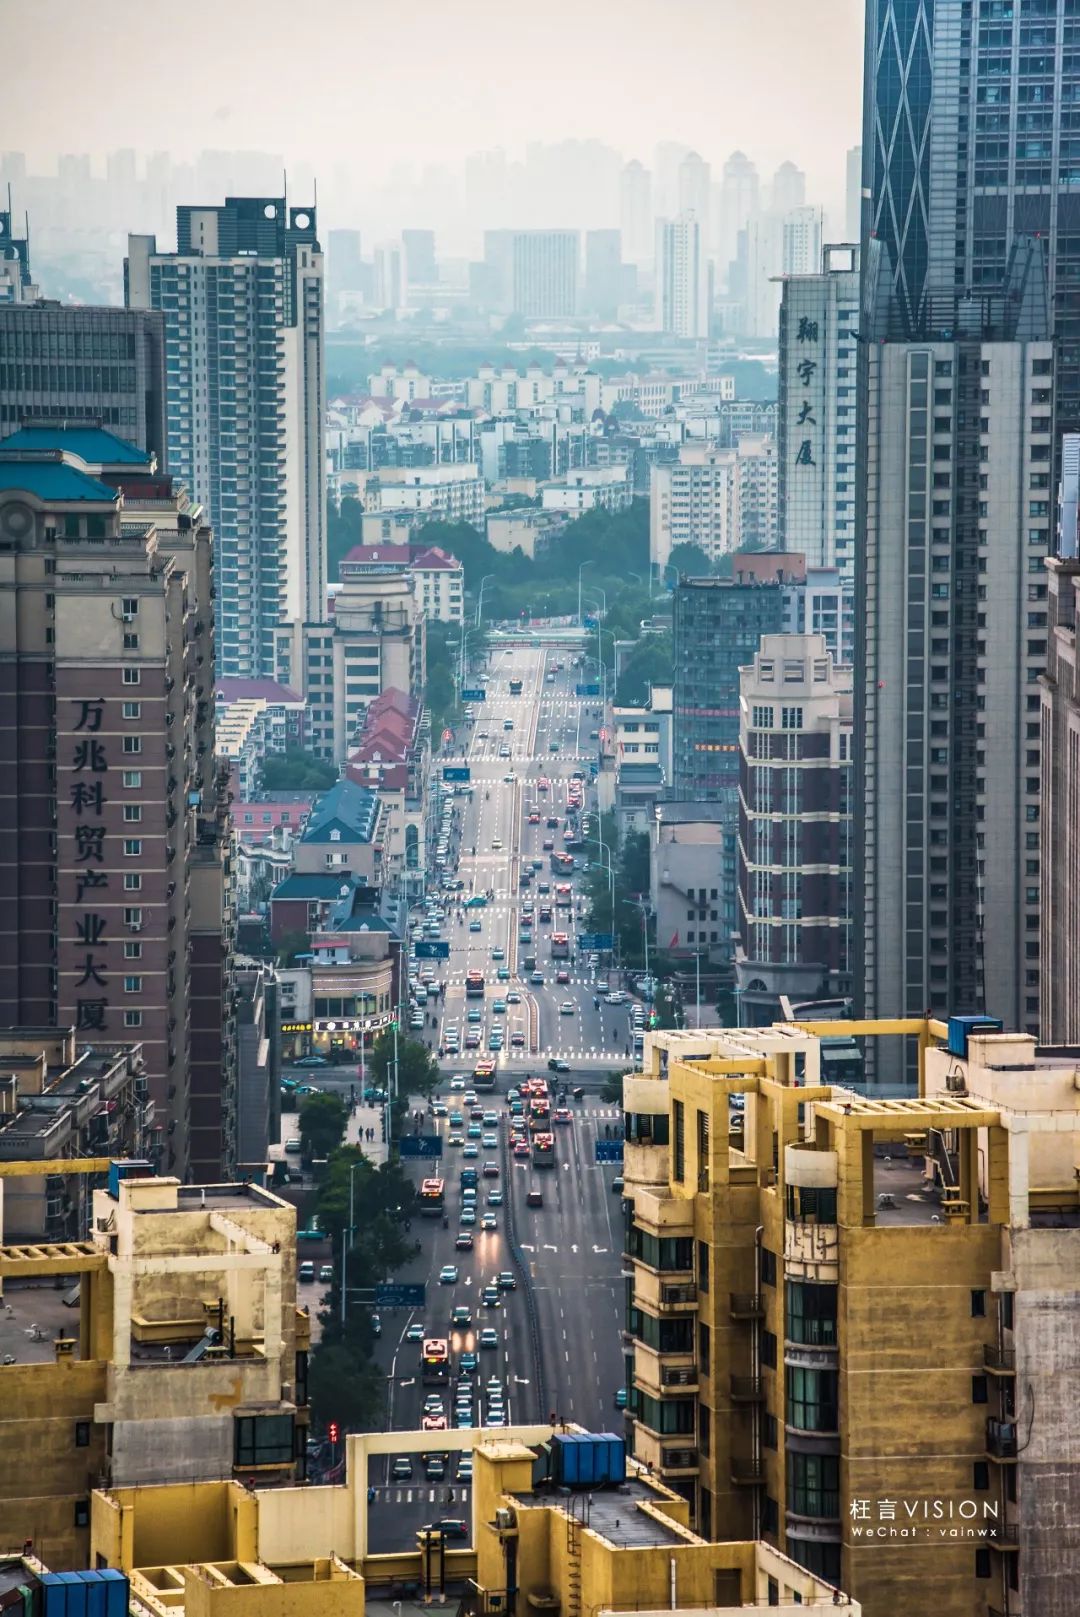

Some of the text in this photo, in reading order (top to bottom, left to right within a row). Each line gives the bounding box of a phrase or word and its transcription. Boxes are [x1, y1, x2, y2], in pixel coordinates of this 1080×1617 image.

[795, 315, 819, 466] 翔宇大厦
[71, 698, 108, 1032] 万兆科贸产业大厦
